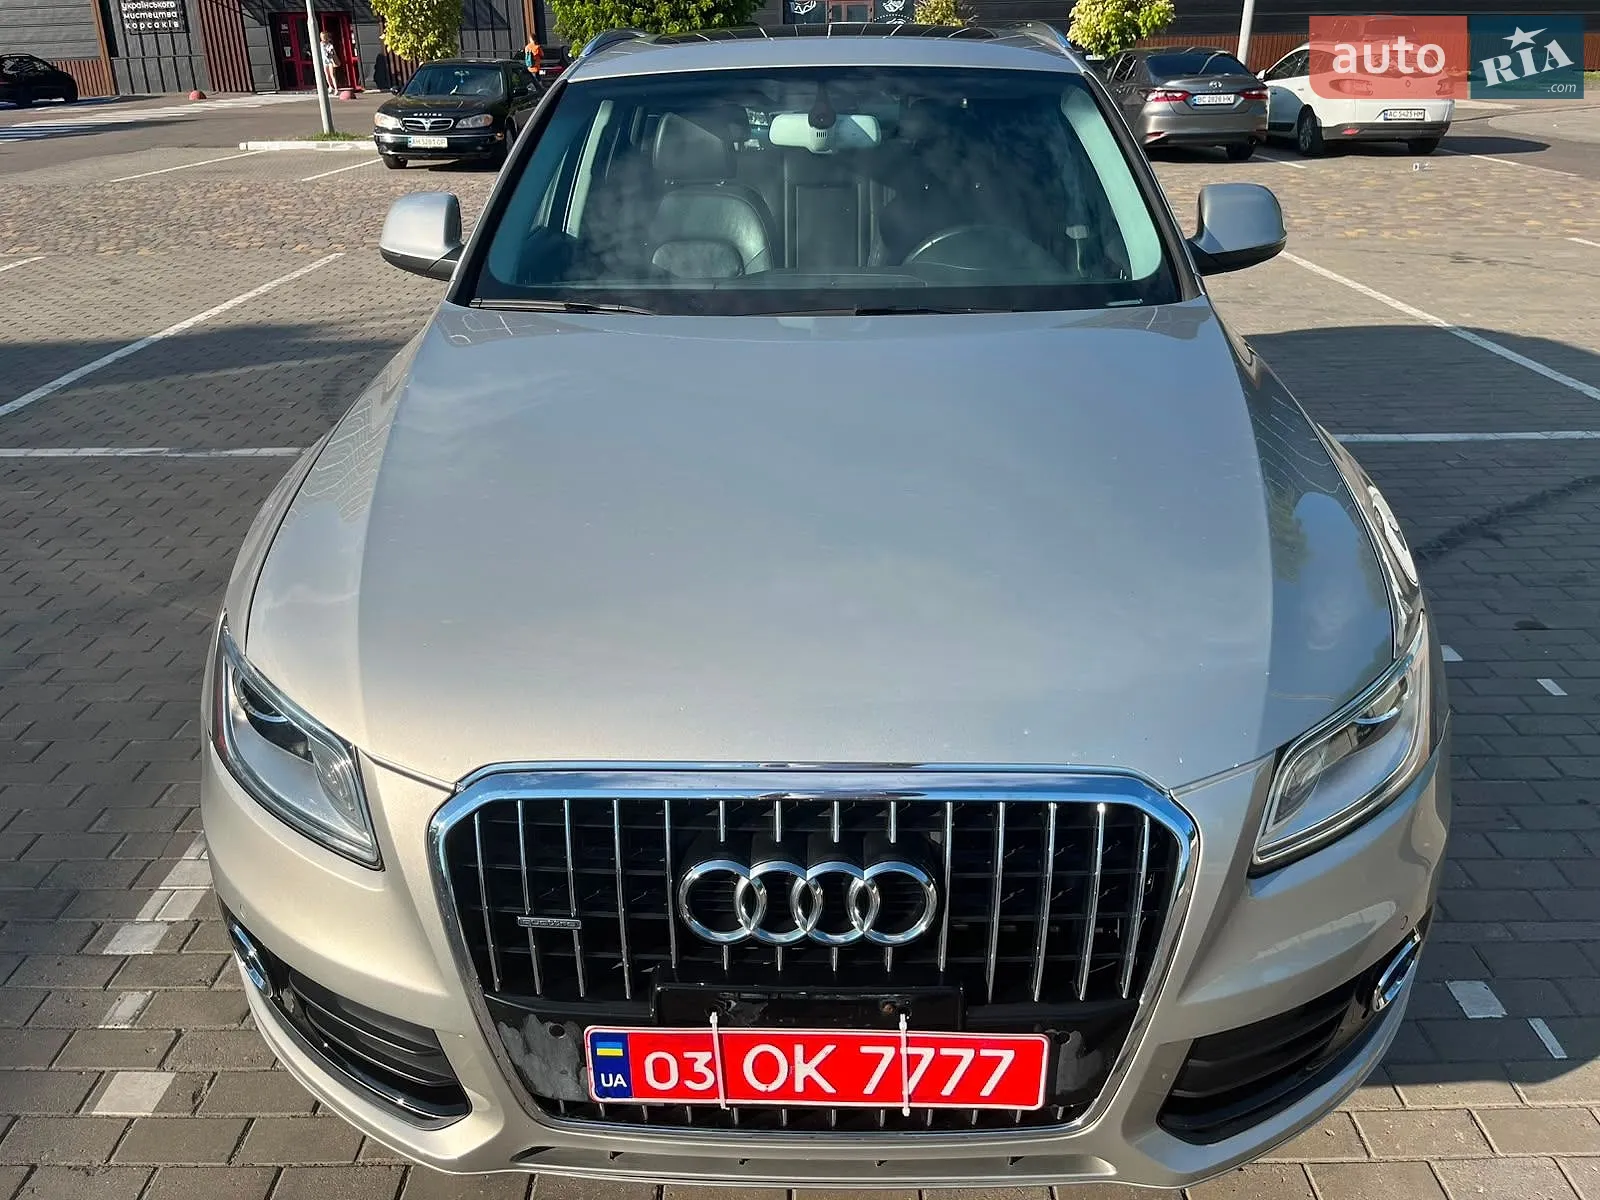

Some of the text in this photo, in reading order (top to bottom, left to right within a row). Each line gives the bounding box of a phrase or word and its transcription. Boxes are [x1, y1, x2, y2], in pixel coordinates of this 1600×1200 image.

[121, 1, 176, 10] українського
[123, 11, 178, 19] мистецтва
[125, 20, 179, 30] корсаків
[601, 1043, 1016, 1098] UA 03 OK 7777
